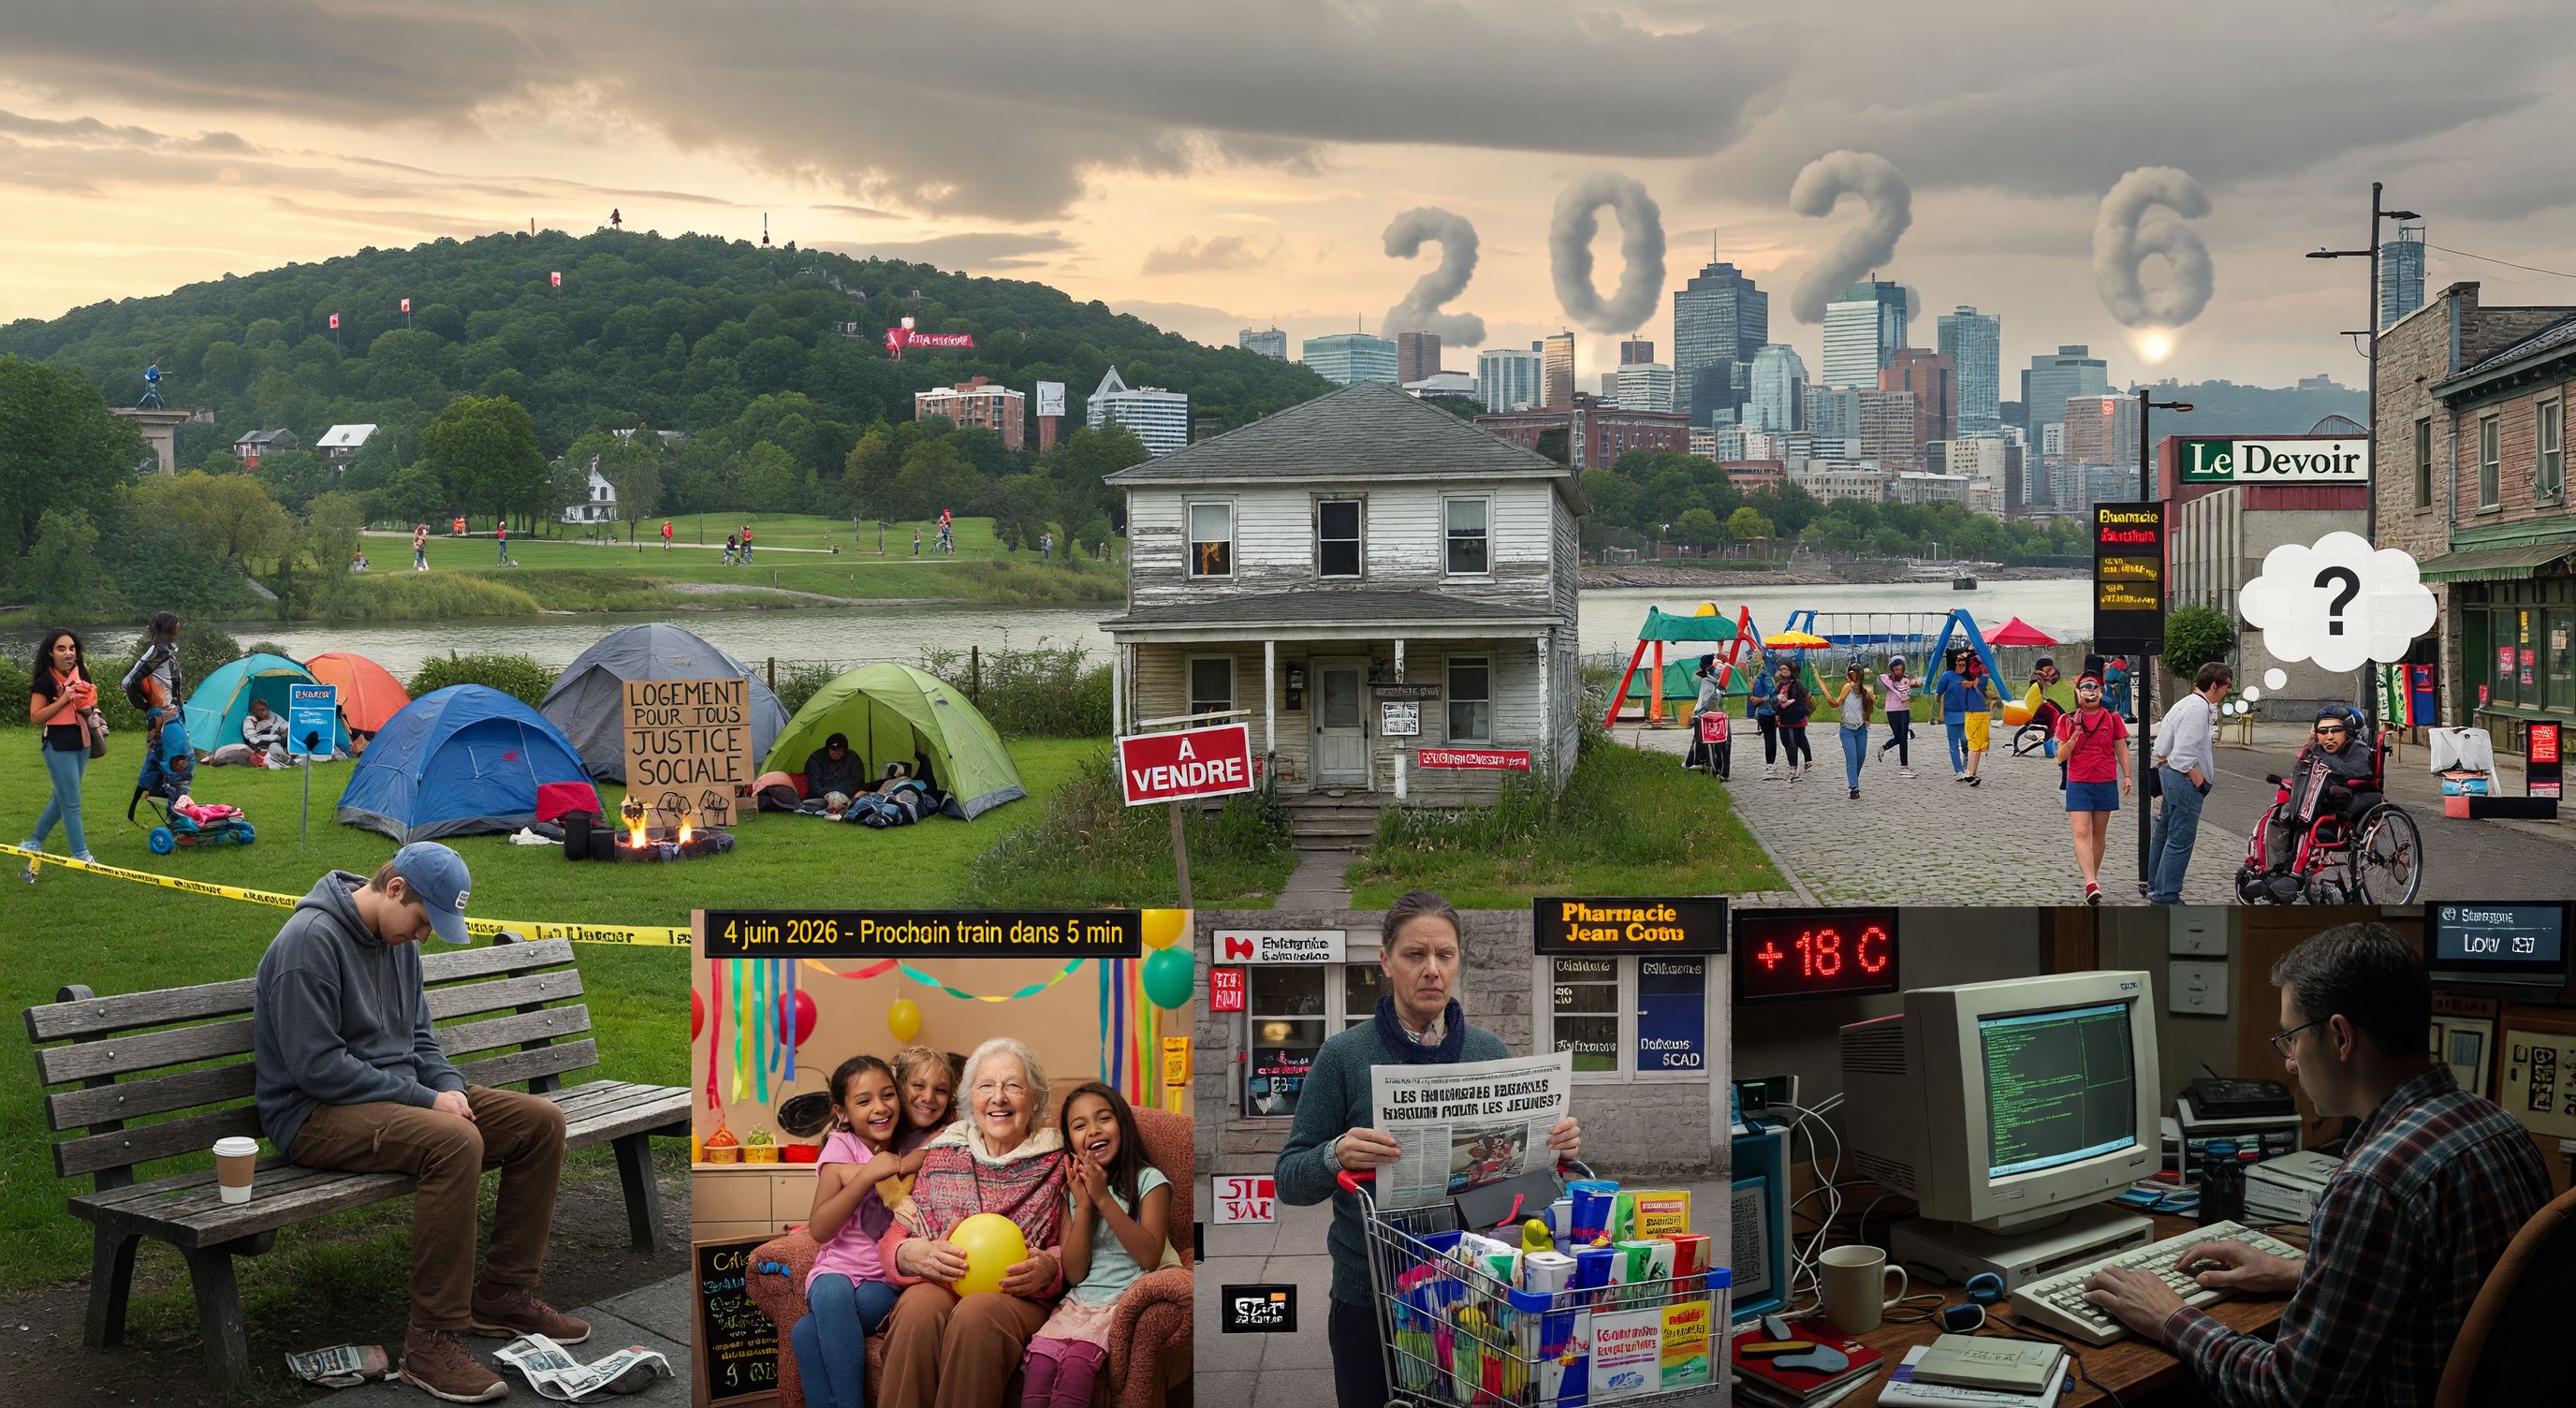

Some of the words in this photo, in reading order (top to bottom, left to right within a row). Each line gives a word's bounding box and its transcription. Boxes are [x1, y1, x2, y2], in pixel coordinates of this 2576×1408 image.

[2190, 443, 2232, 474] Le
[2242, 444, 2361, 475] Devoir
[630, 681, 744, 707] LOGEMENT
[634, 708, 683, 726] POUR
[693, 706, 741, 726] TOUS
[632, 727, 742, 755] JUSTICE
[638, 755, 742, 785] SOCIALE
[1131, 756, 1244, 793] VENDRE
[1561, 902, 1676, 922] Pharmacie
[724, 919, 738, 944] 4
[741, 919, 780, 950] juin
[786, 919, 839, 944] 2026
[957, 920, 1003, 944] train
[1009, 919, 1060, 945] dans
[1067, 919, 1079, 944] 5
[1087, 919, 1123, 944] min
[1566, 923, 1619, 942] Jean
[1858, 926, 1887, 973] C
[1662, 1052, 1701, 1066] SCAD
[1393, 1090, 1416, 1104] LES
[1483, 1101, 1503, 1115] LES
